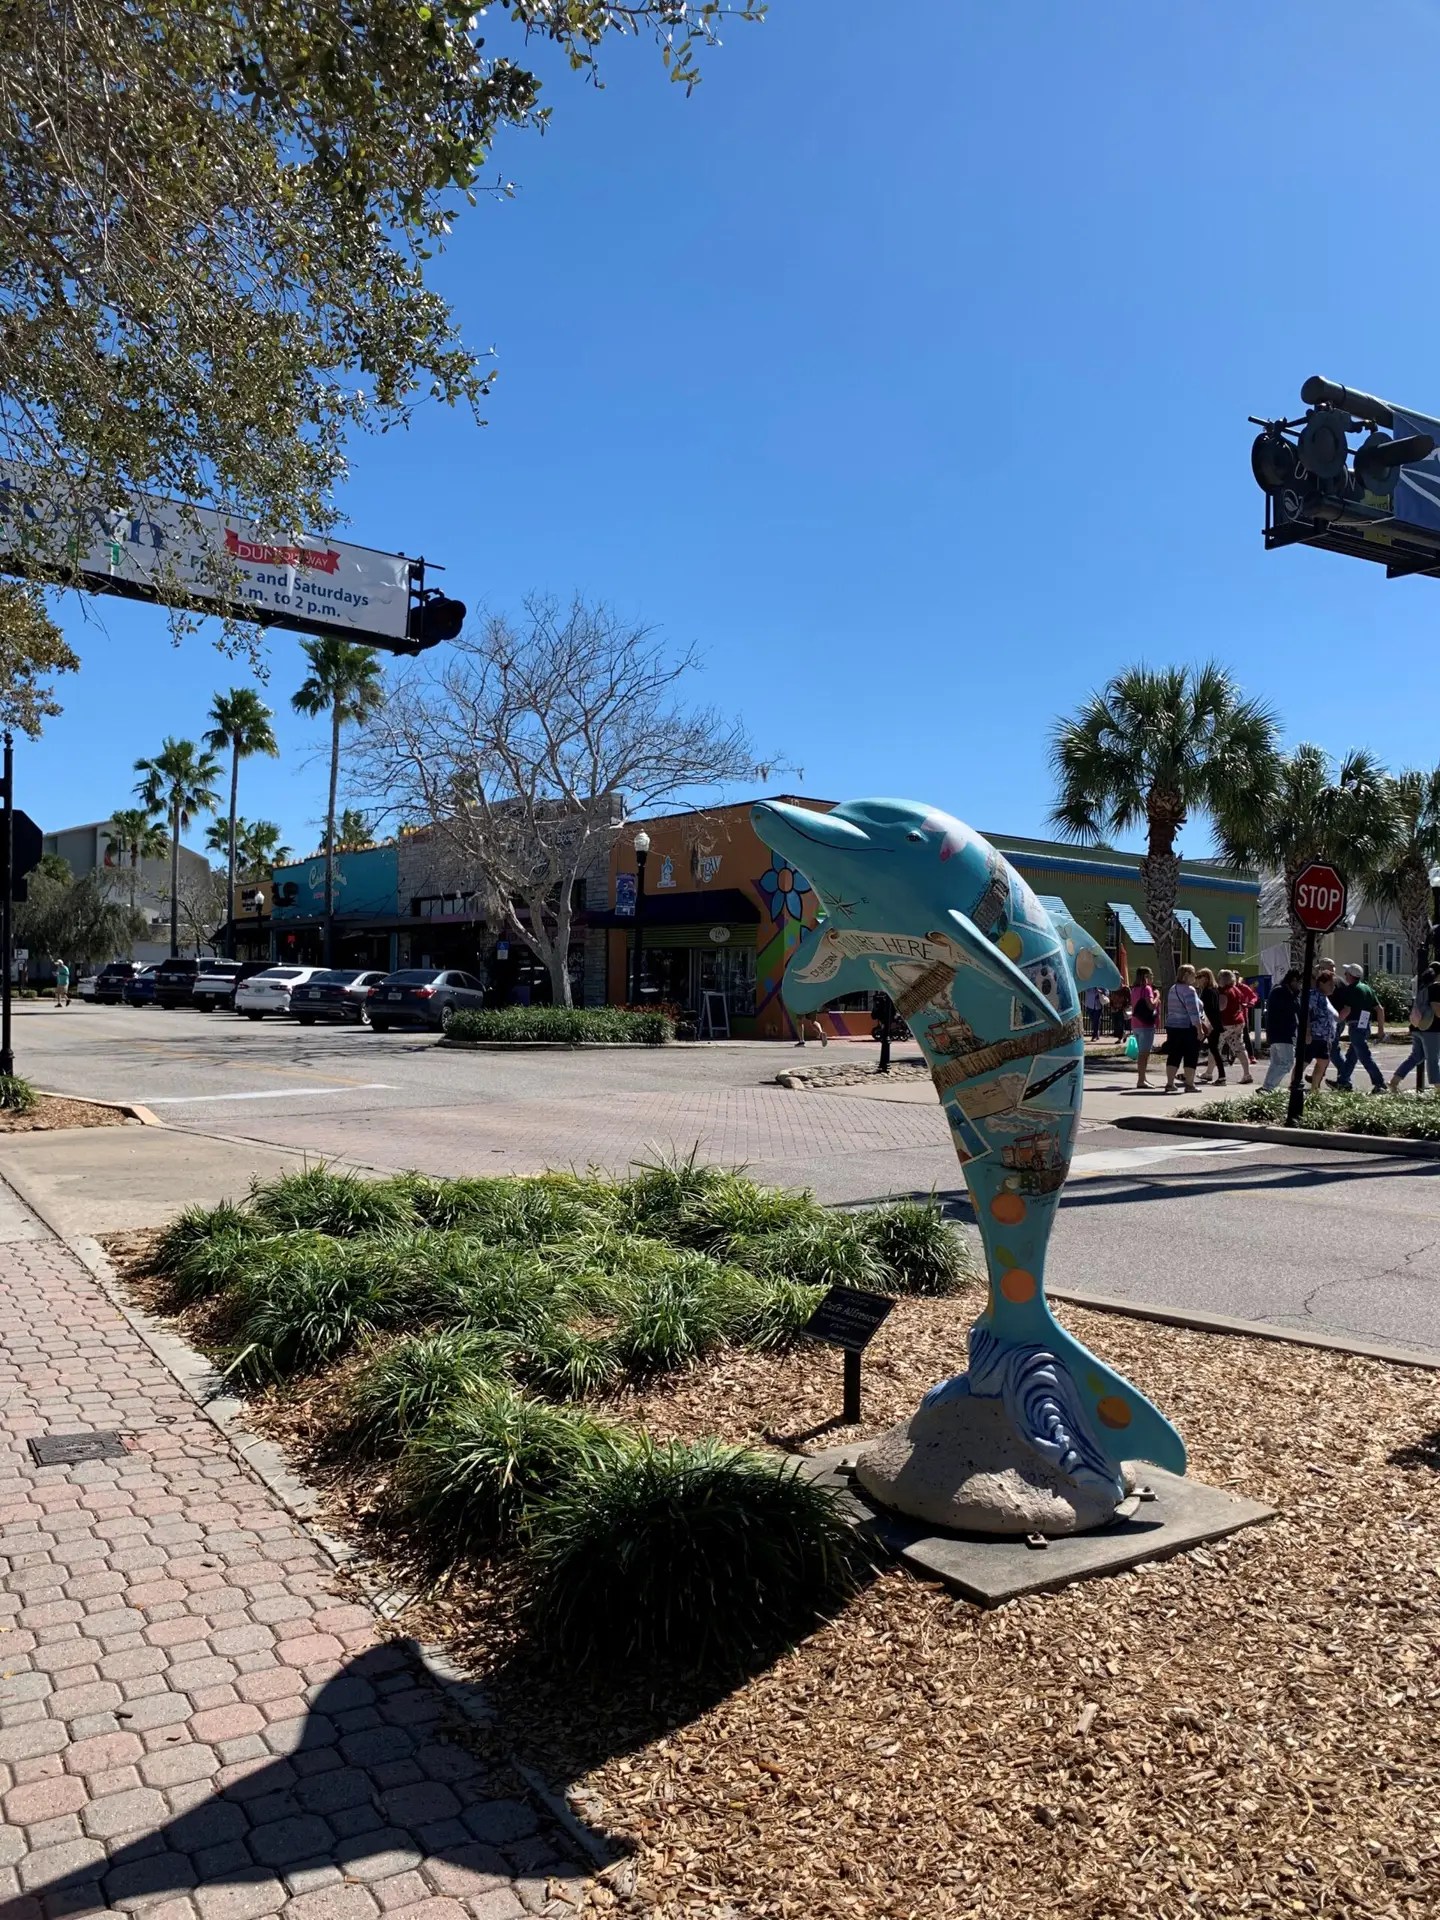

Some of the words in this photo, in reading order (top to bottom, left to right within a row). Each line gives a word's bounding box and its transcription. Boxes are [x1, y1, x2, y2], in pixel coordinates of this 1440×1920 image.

[257, 572, 288, 587] and
[294, 577, 369, 607] Saturdays
[274, 591, 290, 605] to
[295, 595, 303, 609] 2
[307, 601, 340, 617] p.m.
[1298, 884, 1340, 911] STOP
[881, 937, 934, 961] HERE
